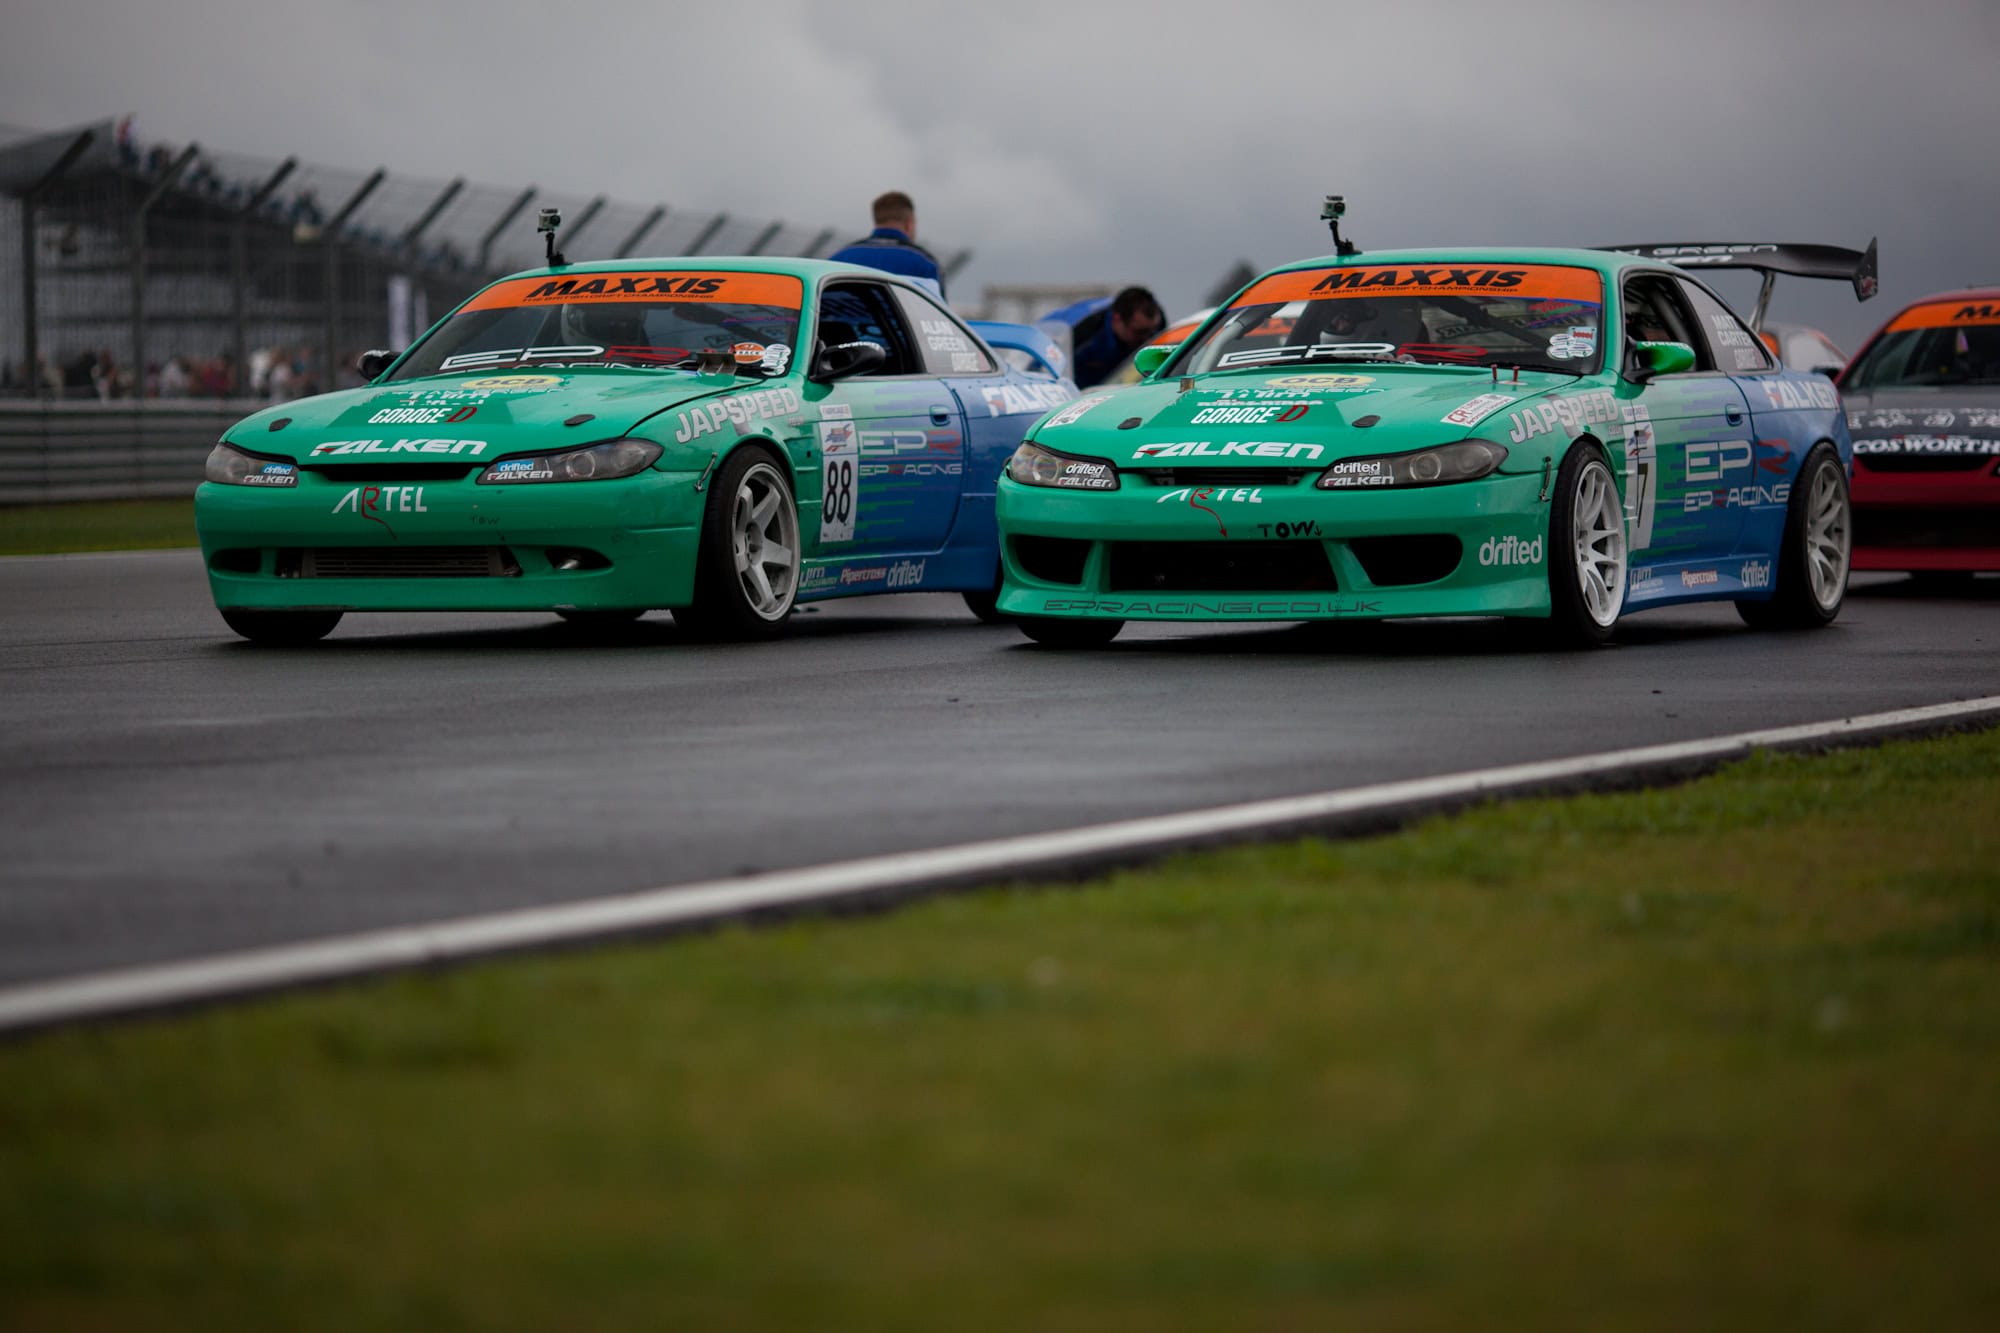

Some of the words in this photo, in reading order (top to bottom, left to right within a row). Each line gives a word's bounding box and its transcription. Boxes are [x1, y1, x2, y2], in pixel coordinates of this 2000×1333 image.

[526, 277, 727, 298] MAXXIS
[1311, 269, 1529, 291] MAXXIS
[440, 345, 690, 370] EPR
[1217, 343, 1488, 368] EPR
[675, 387, 799, 443] JAPSPEED
[1508, 390, 1619, 443] JAPSPEED
[309, 439, 488, 457] FALKEN
[857, 430, 962, 456] EPR
[1132, 441, 1325, 459] FALKEN
[1852, 438, 2000, 455] COSWORTH
[1065, 463, 1106, 475] drifted
[1334, 461, 1380, 473] drifted
[1685, 438, 1790, 482] EPR
[243, 475, 295, 484] FALKEN
[487, 470, 553, 481] FALKEN
[1324, 476, 1394, 487] FALKEN
[331, 486, 428, 520] ARTEL
[823, 460, 852, 524] 88
[1156, 486, 1262, 513] ARTEL
[1479, 534, 1543, 566] drifted
[887, 558, 926, 587] drifted
[1741, 560, 1771, 588] drifted
